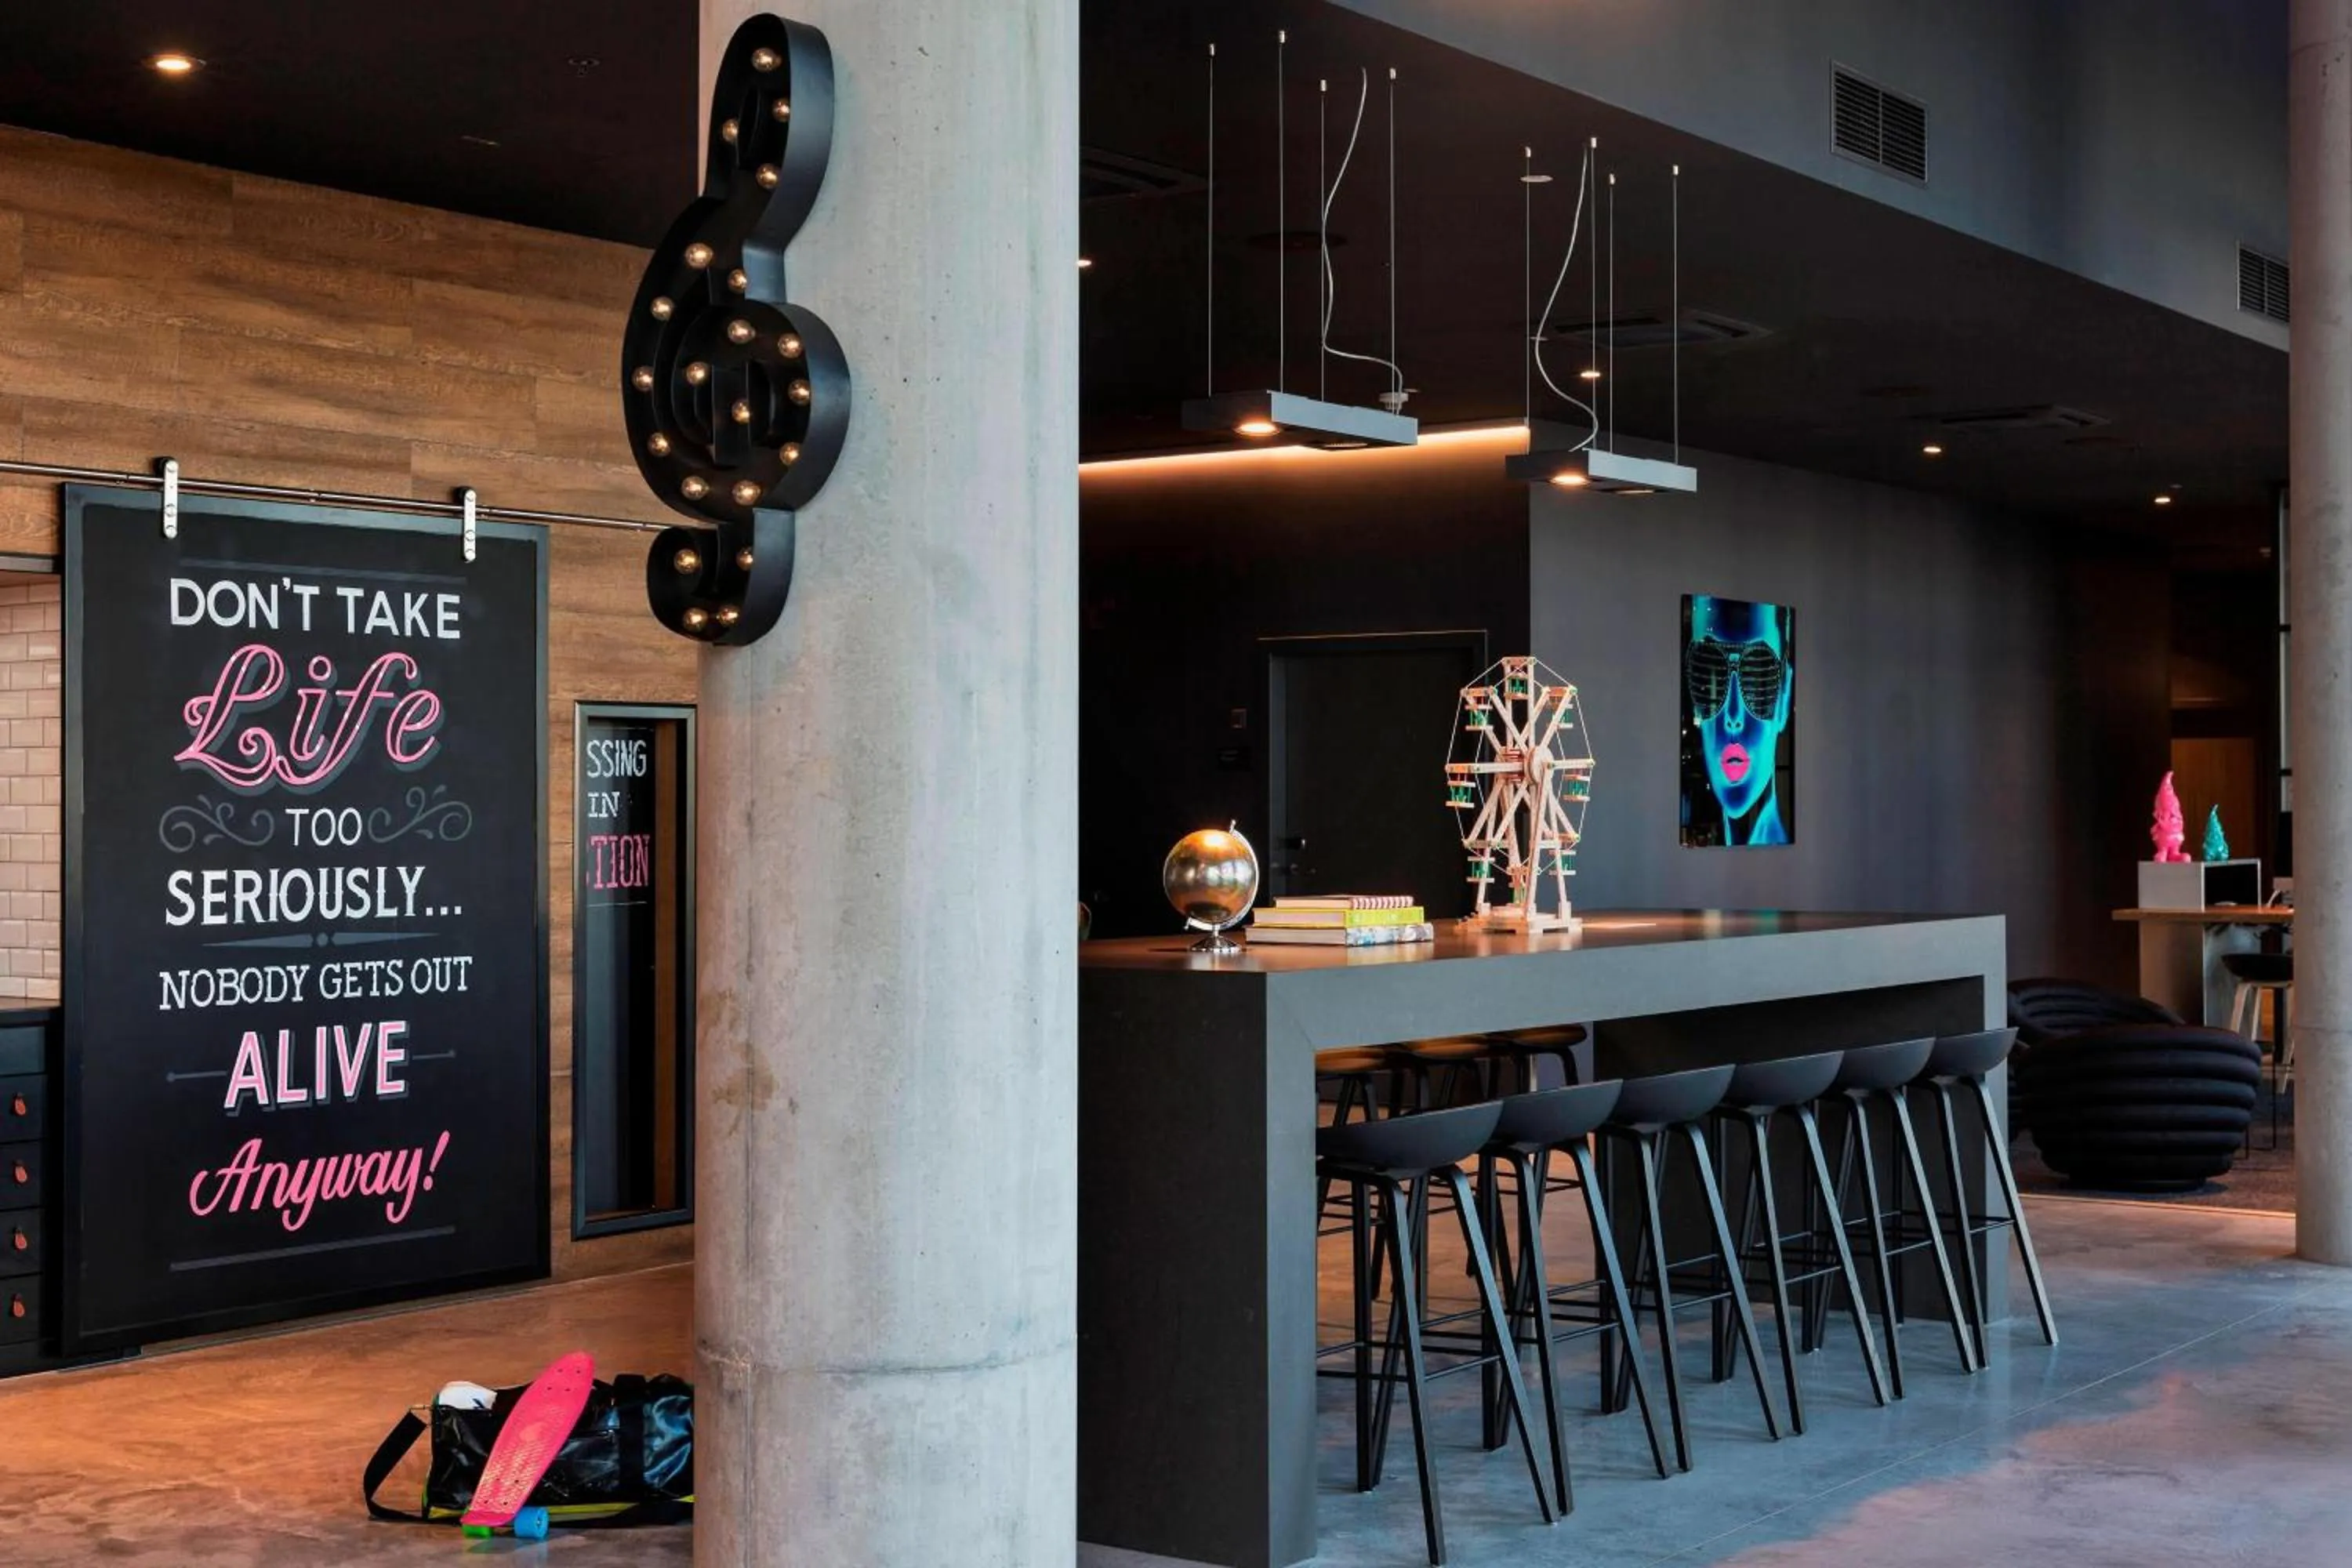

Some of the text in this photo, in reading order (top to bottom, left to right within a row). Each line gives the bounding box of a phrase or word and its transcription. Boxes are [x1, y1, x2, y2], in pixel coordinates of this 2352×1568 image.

[171, 578, 460, 639] DON'T TAKE
[175, 644, 441, 786] Life
[285, 808, 362, 846] TOO
[588, 791, 620, 818] IN
[586, 835, 650, 889] TION
[165, 866, 462, 926] SERIOUSLY...
[159, 956, 473, 1011] NOBODY GETS OUT
[224, 1020, 408, 1109] ALIVE
[189, 1131, 451, 1232] Anyway!
